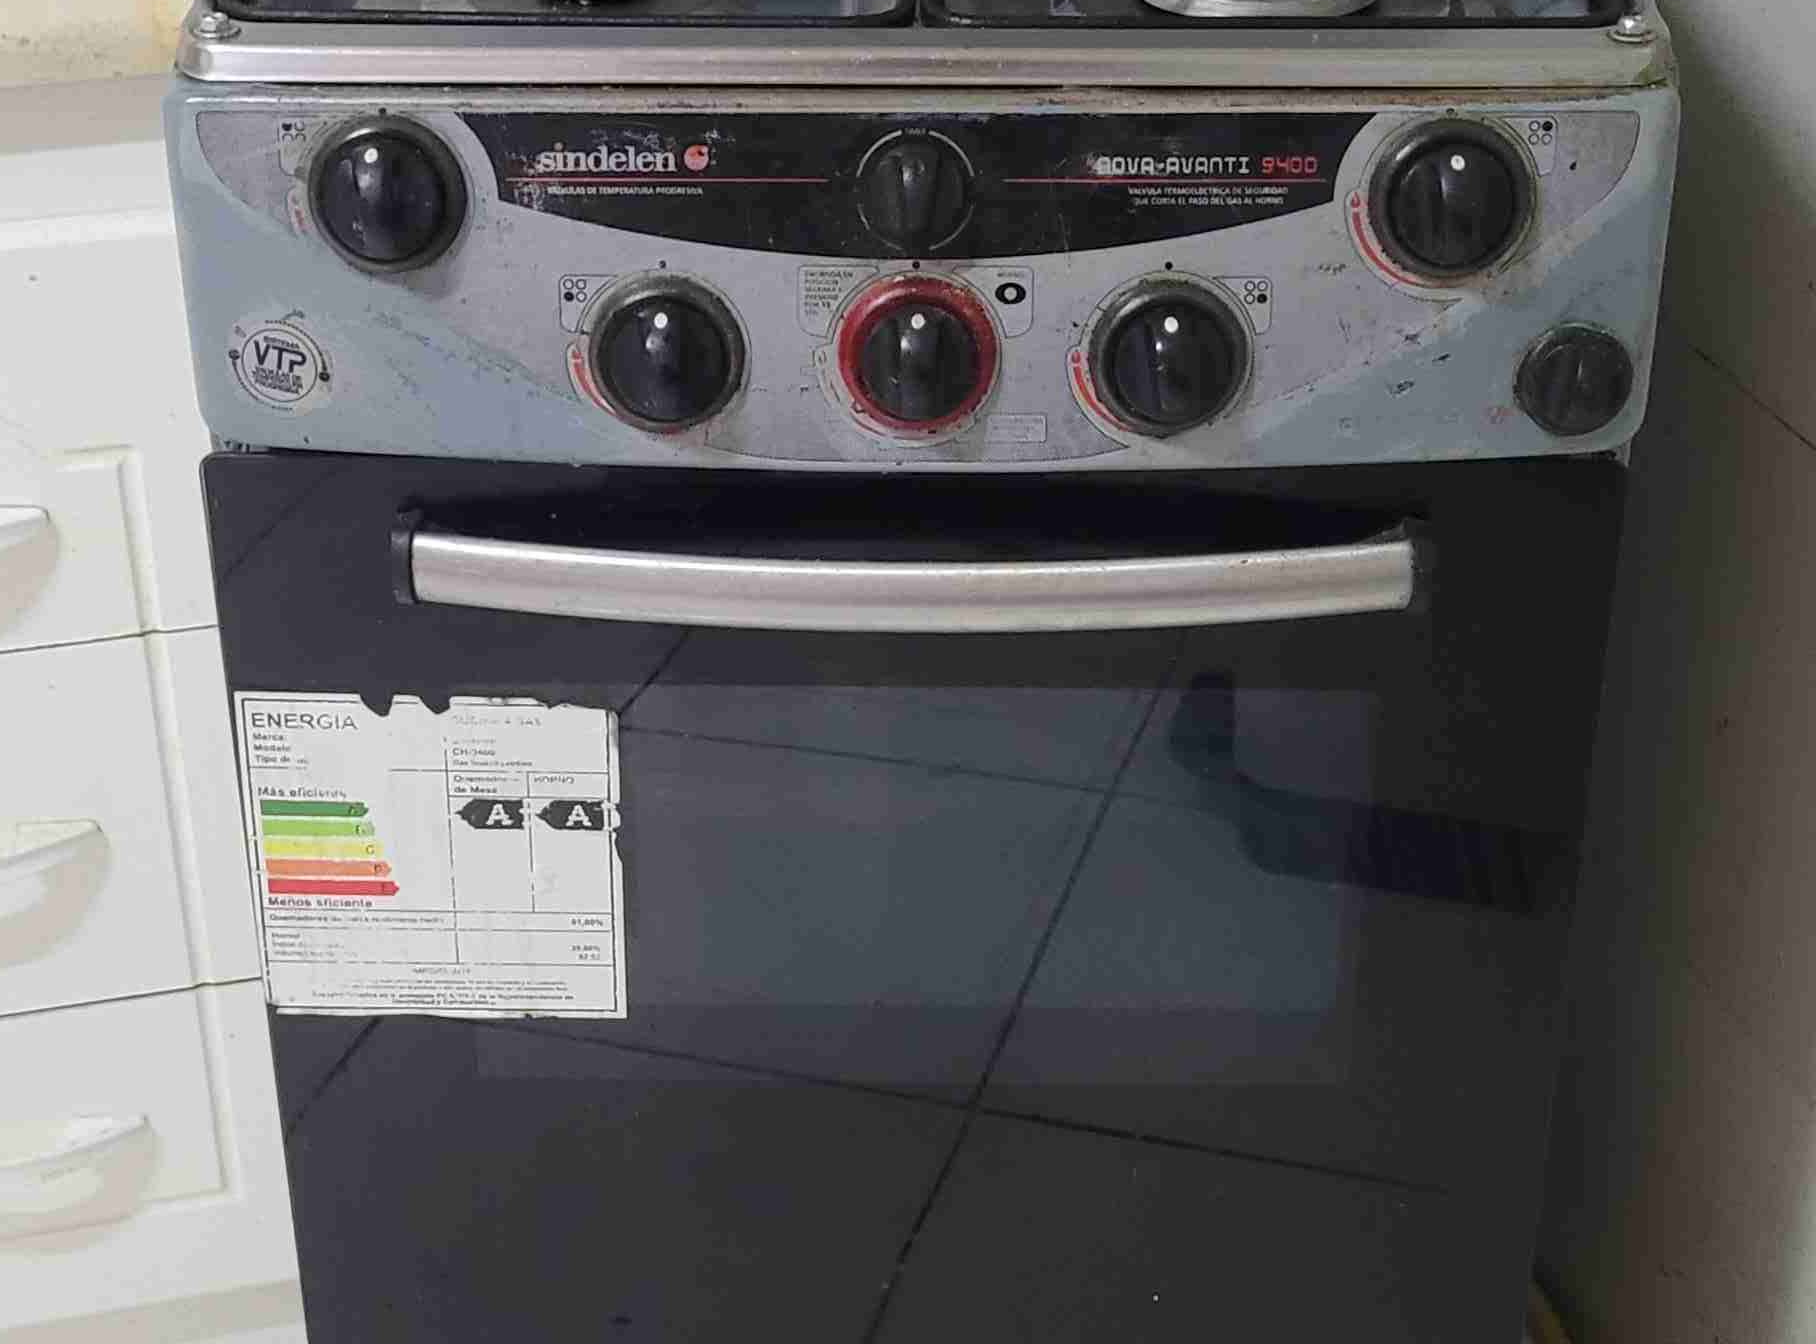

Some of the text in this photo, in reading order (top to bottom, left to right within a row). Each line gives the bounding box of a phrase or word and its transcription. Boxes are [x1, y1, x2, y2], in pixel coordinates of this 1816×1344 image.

[538, 142, 678, 172] sindelen
[598, 186, 654, 195] TEMPERATURA
[1188, 196, 1208, 205] PASO
[253, 339, 307, 374] VTP
[251, 712, 359, 731] ENERGIA
[484, 802, 514, 826] A
[565, 804, 593, 827] A
